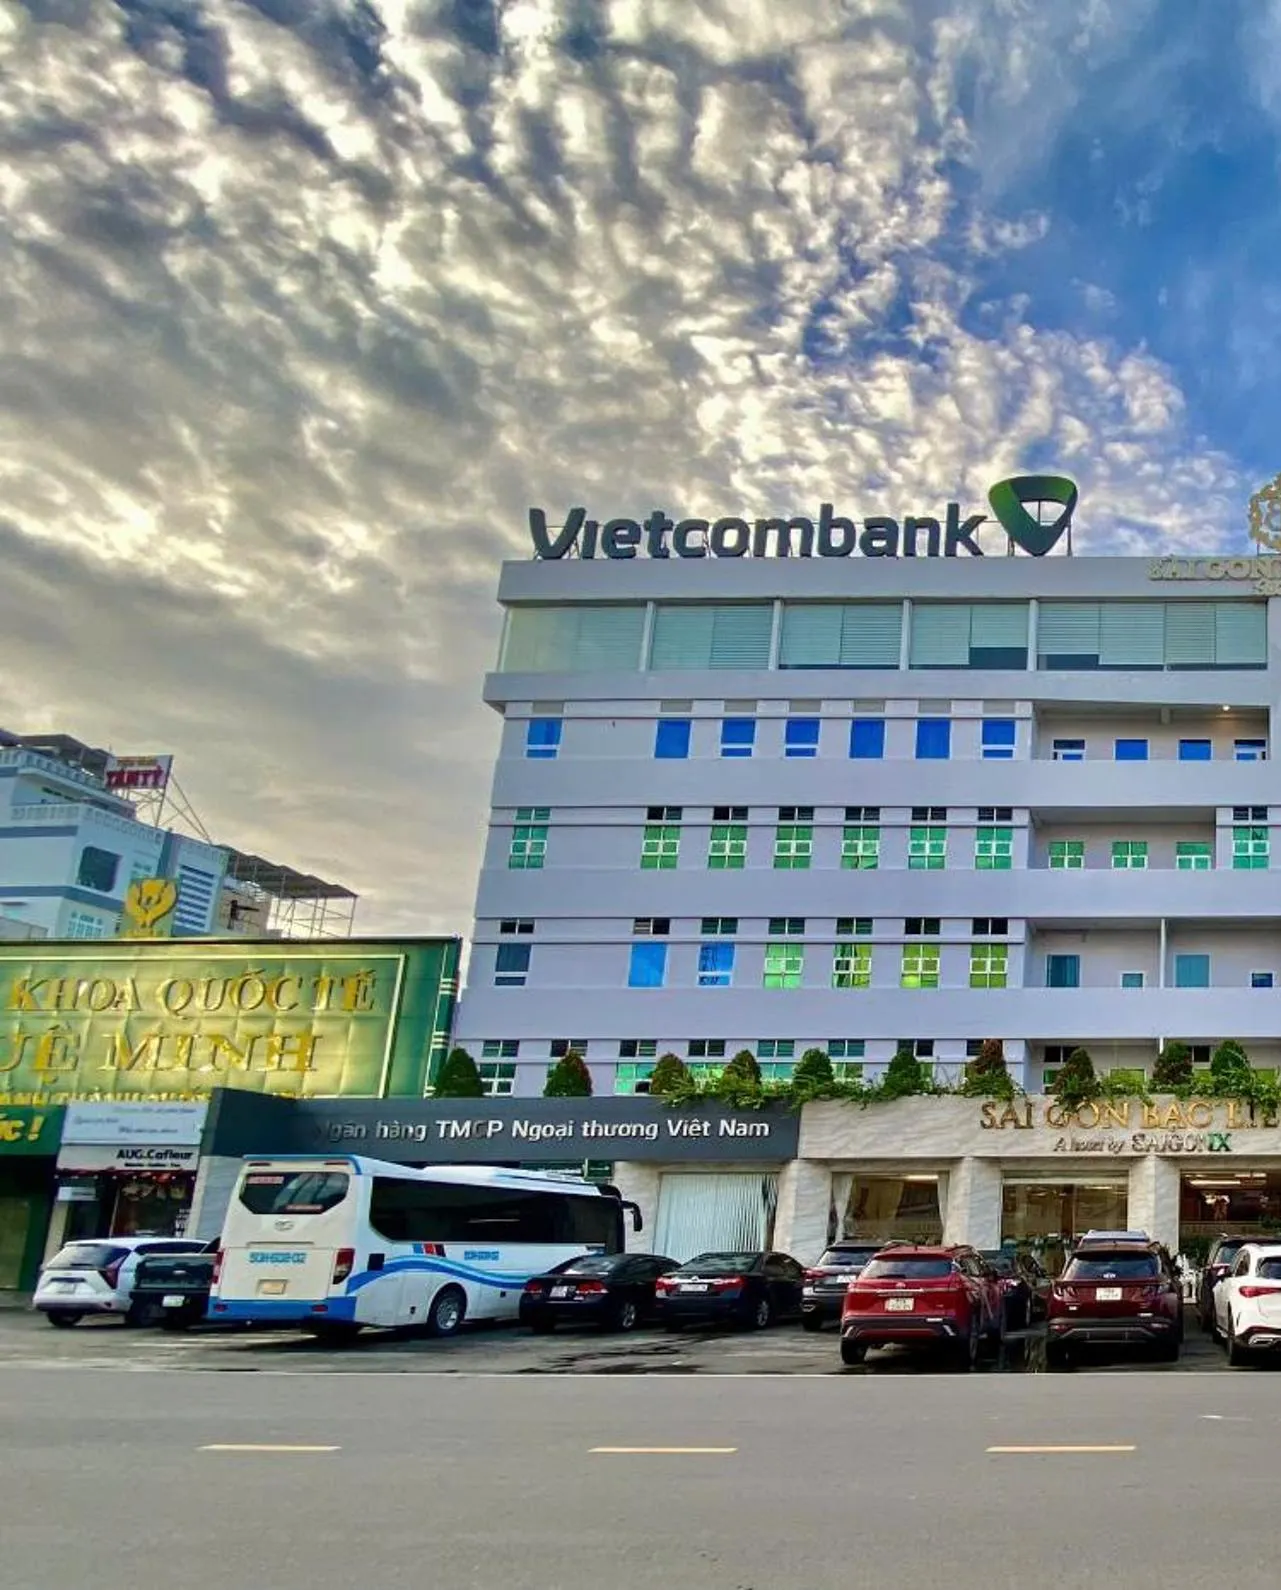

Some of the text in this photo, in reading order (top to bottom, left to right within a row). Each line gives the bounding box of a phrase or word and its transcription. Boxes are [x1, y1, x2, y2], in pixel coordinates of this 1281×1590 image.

[529, 503, 987, 560] Vietcombank
[8, 969, 377, 1019] KHOA QUỐC TẾ
[100, 1033, 323, 1072] MINH
[375, 1120, 427, 1142] hàng
[435, 1119, 503, 1139] TMCP
[511, 1120, 575, 1142] Ngoại
[582, 1121, 658, 1140] thương
[667, 1118, 711, 1141] Việt
[718, 1119, 769, 1137] Nam
